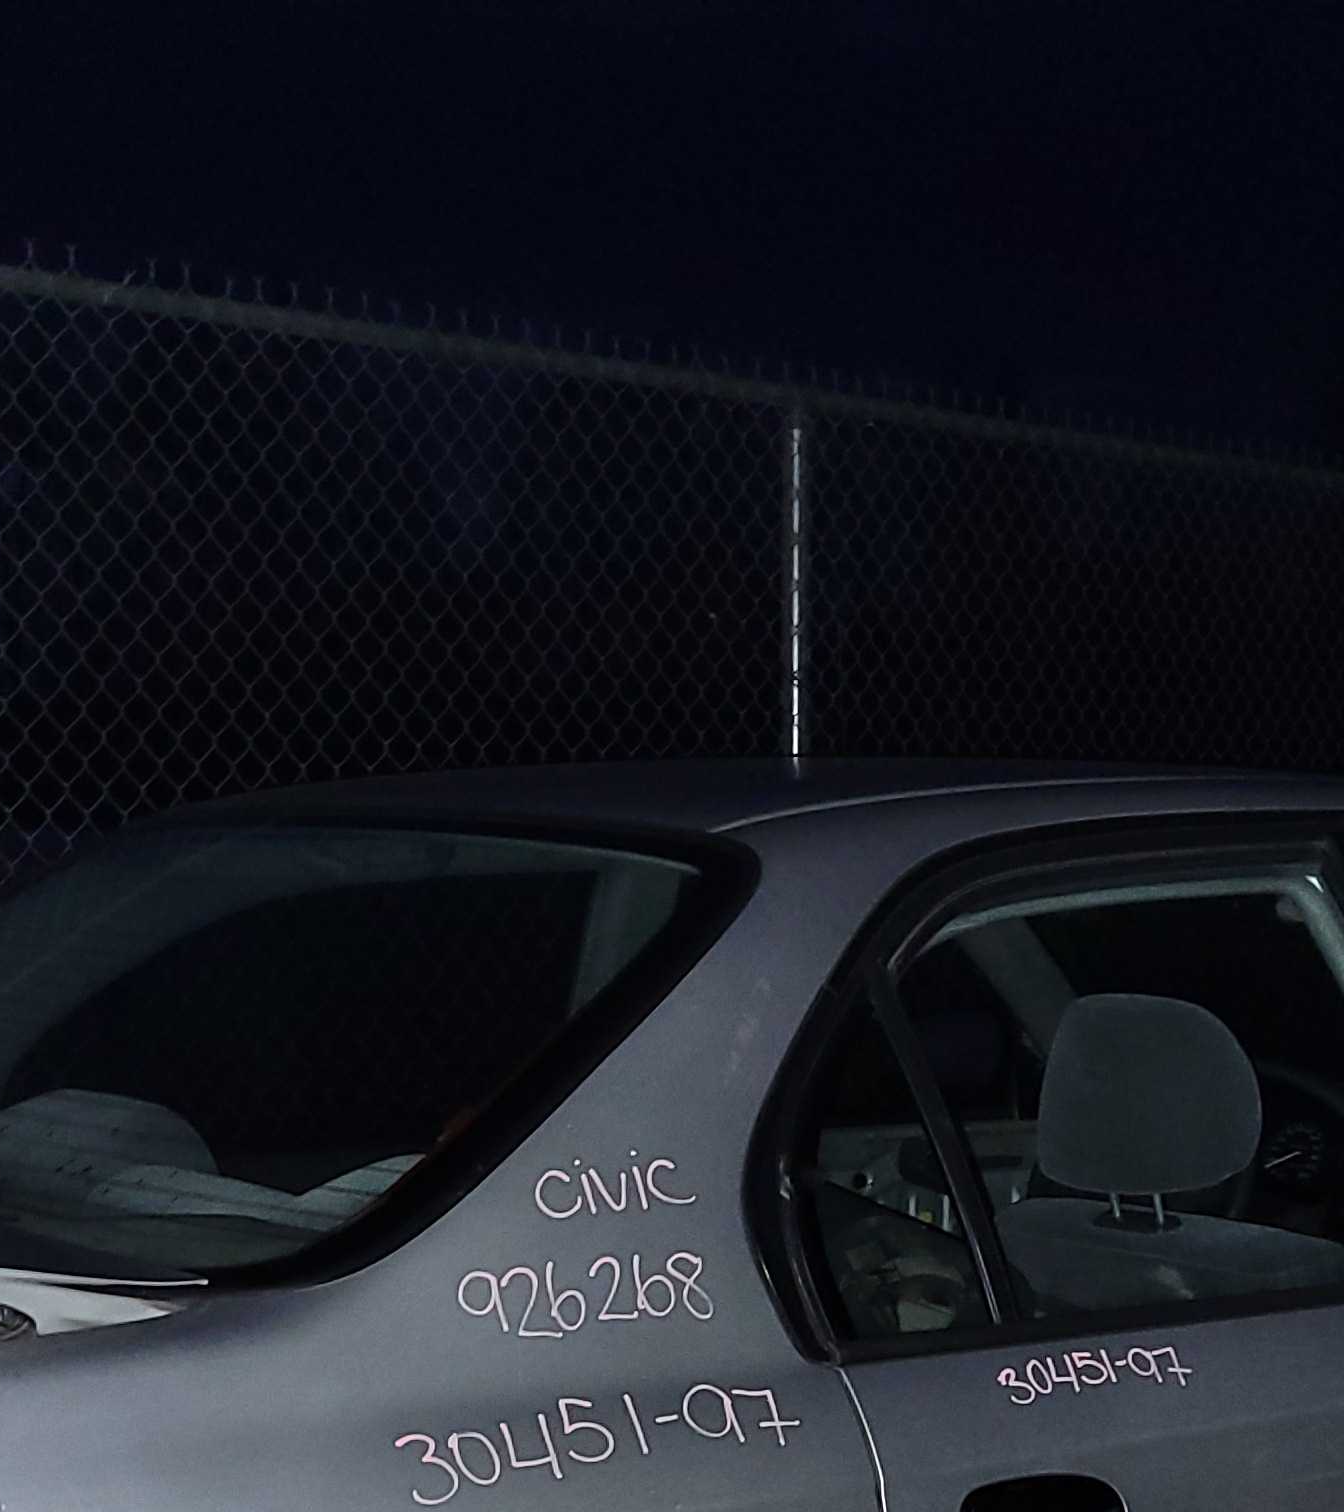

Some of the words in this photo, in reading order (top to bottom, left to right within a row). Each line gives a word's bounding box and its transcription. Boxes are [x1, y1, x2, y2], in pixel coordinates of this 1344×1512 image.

[457, 1251, 714, 1338] 926268
[996, 1346, 1193, 1405] 30451-97
[394, 1383, 801, 1506] 30451-97
